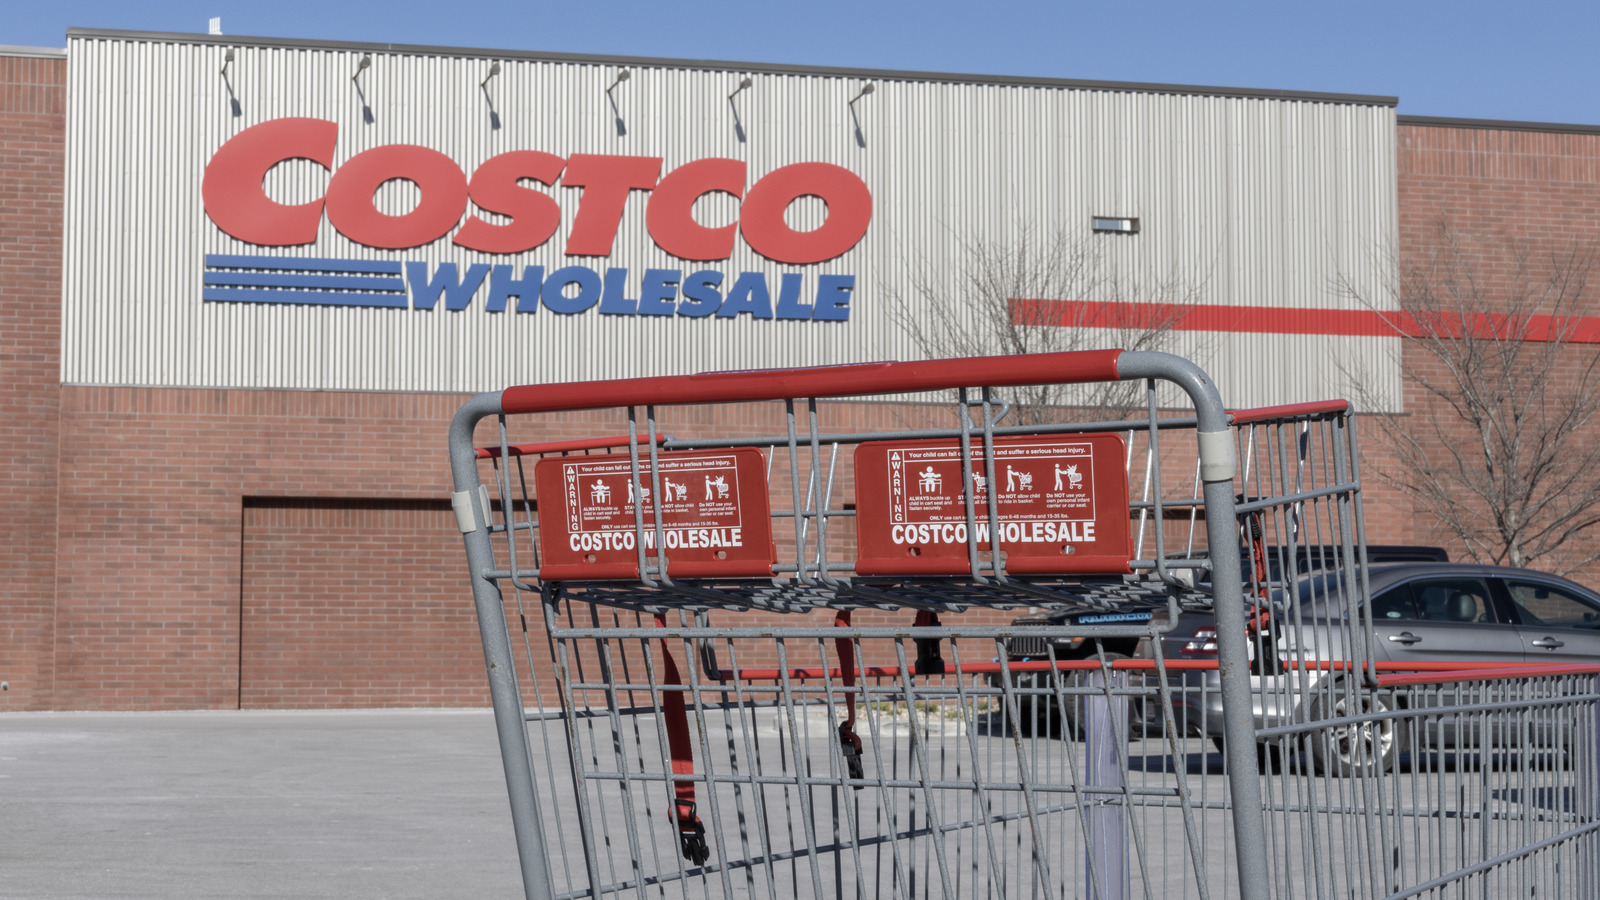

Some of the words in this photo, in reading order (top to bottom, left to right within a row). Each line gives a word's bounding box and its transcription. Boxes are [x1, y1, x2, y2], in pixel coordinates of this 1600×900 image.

[202, 116, 873, 264] COSTCO
[405, 261, 855, 322] WHOLESALE
[567, 474, 579, 530] WARNING
[892, 461, 903, 522] WARNING
[570, 532, 635, 552] COSTCO
[892, 524, 968, 544] COSTCO
